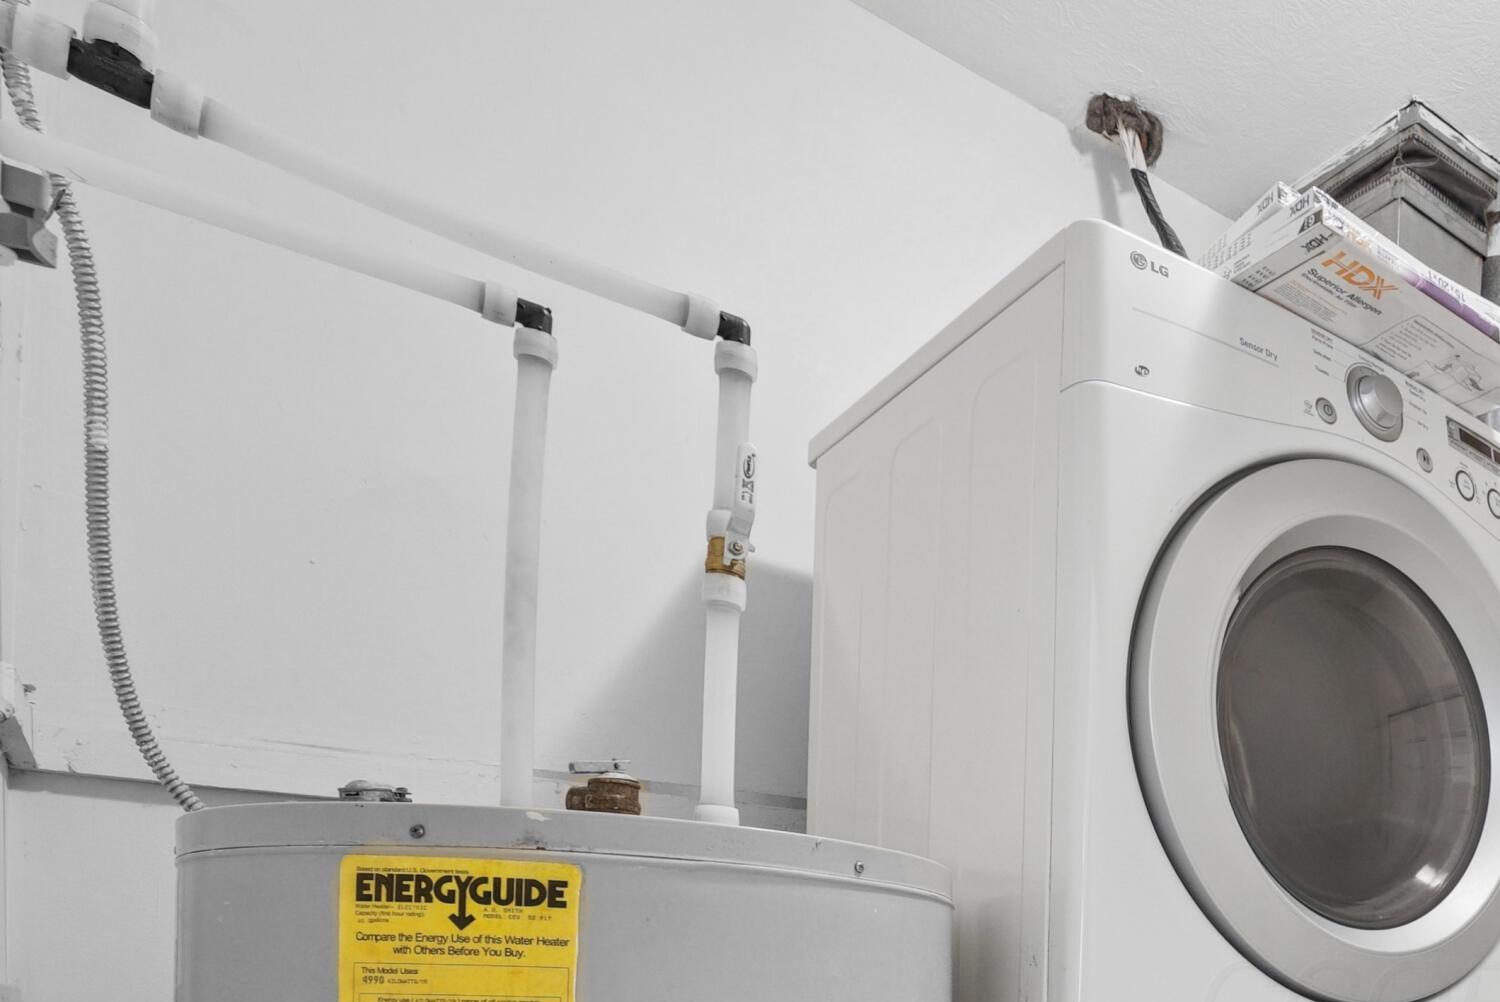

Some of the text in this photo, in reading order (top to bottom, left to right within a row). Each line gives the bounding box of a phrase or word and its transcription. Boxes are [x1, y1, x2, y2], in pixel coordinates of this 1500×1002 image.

[1321, 251, 1399, 300] HDX
[1306, 267, 1348, 295] Superior
[1347, 292, 1382, 316] Allergen
[1239, 337, 1278, 361] Sensor Dry
[356, 872, 568, 909] ENERGYGUIDE
[356, 931, 570, 947] Compare the Energy Use of this Water Heater
[393, 945, 526, 960] with Others Before You Buy.
